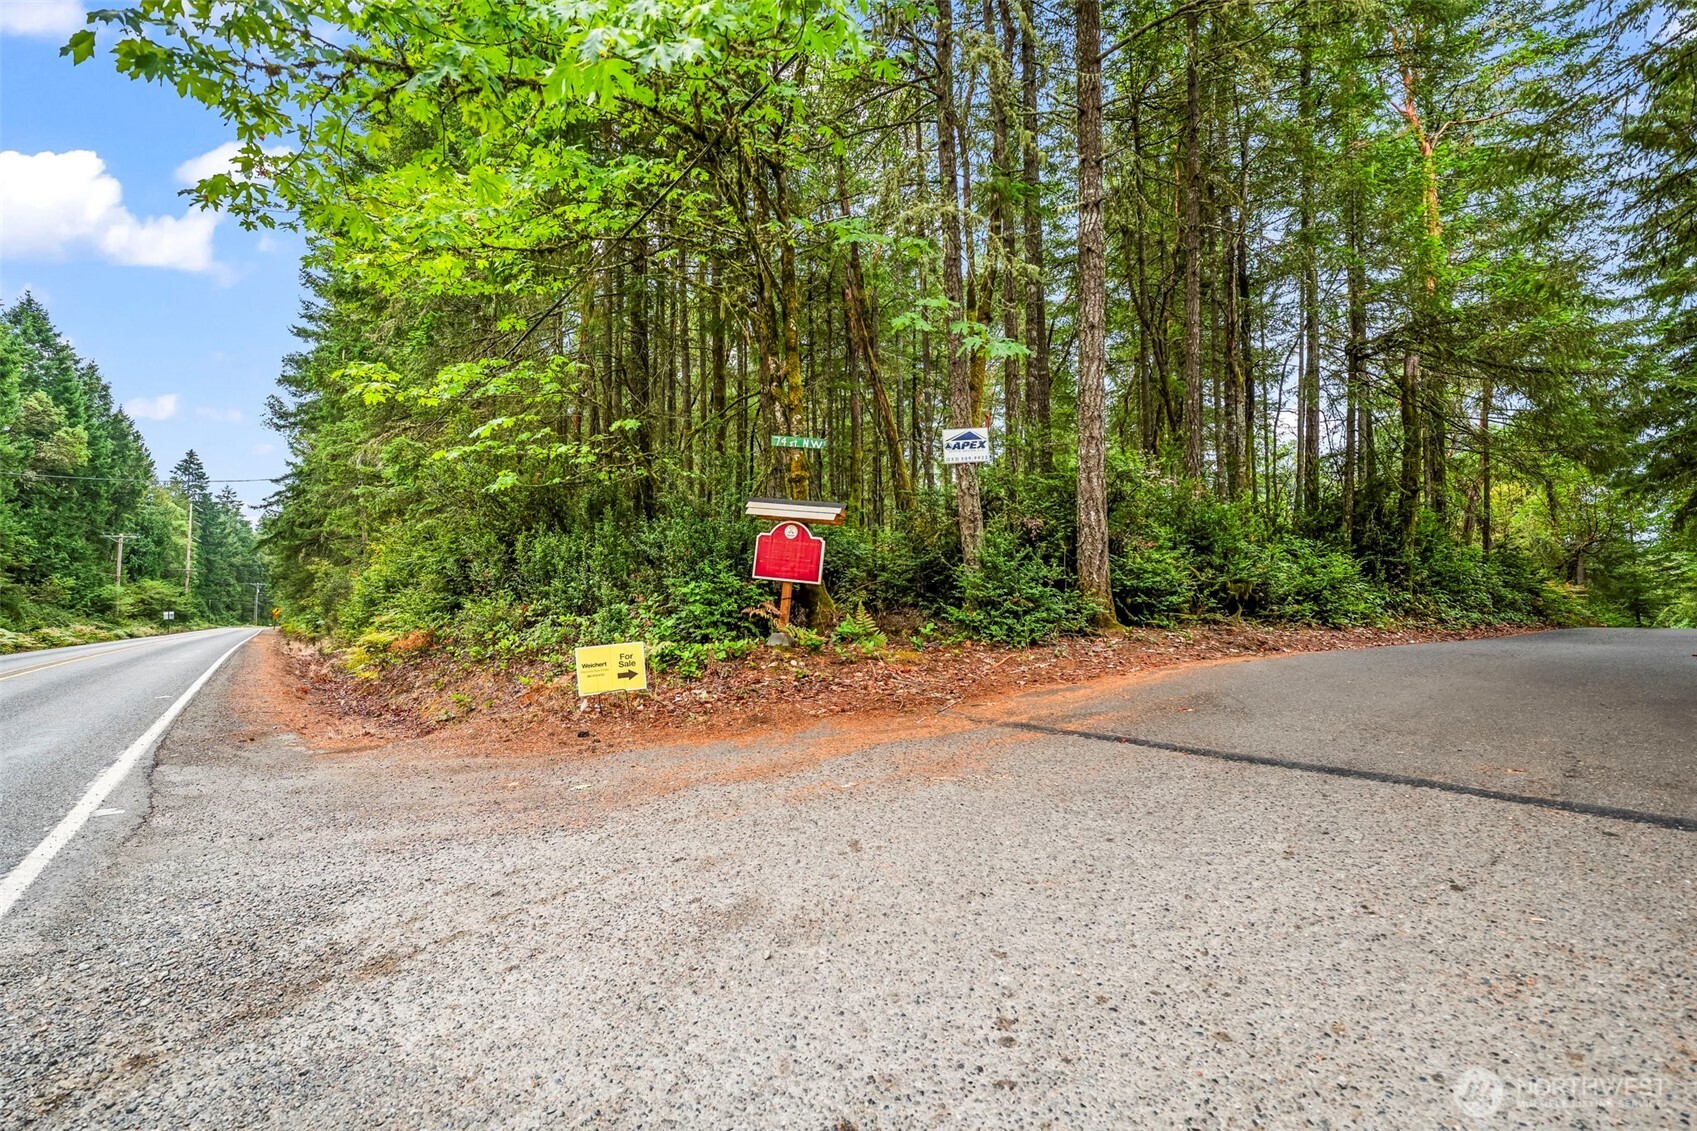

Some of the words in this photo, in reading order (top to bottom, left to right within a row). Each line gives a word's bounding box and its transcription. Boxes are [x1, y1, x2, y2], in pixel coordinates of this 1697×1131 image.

[773, 436, 787, 447] 74
[951, 440, 987, 450] APEX
[619, 652, 634, 661] For
[581, 661, 607, 669] Weichert
[618, 660, 637, 668] Sale
